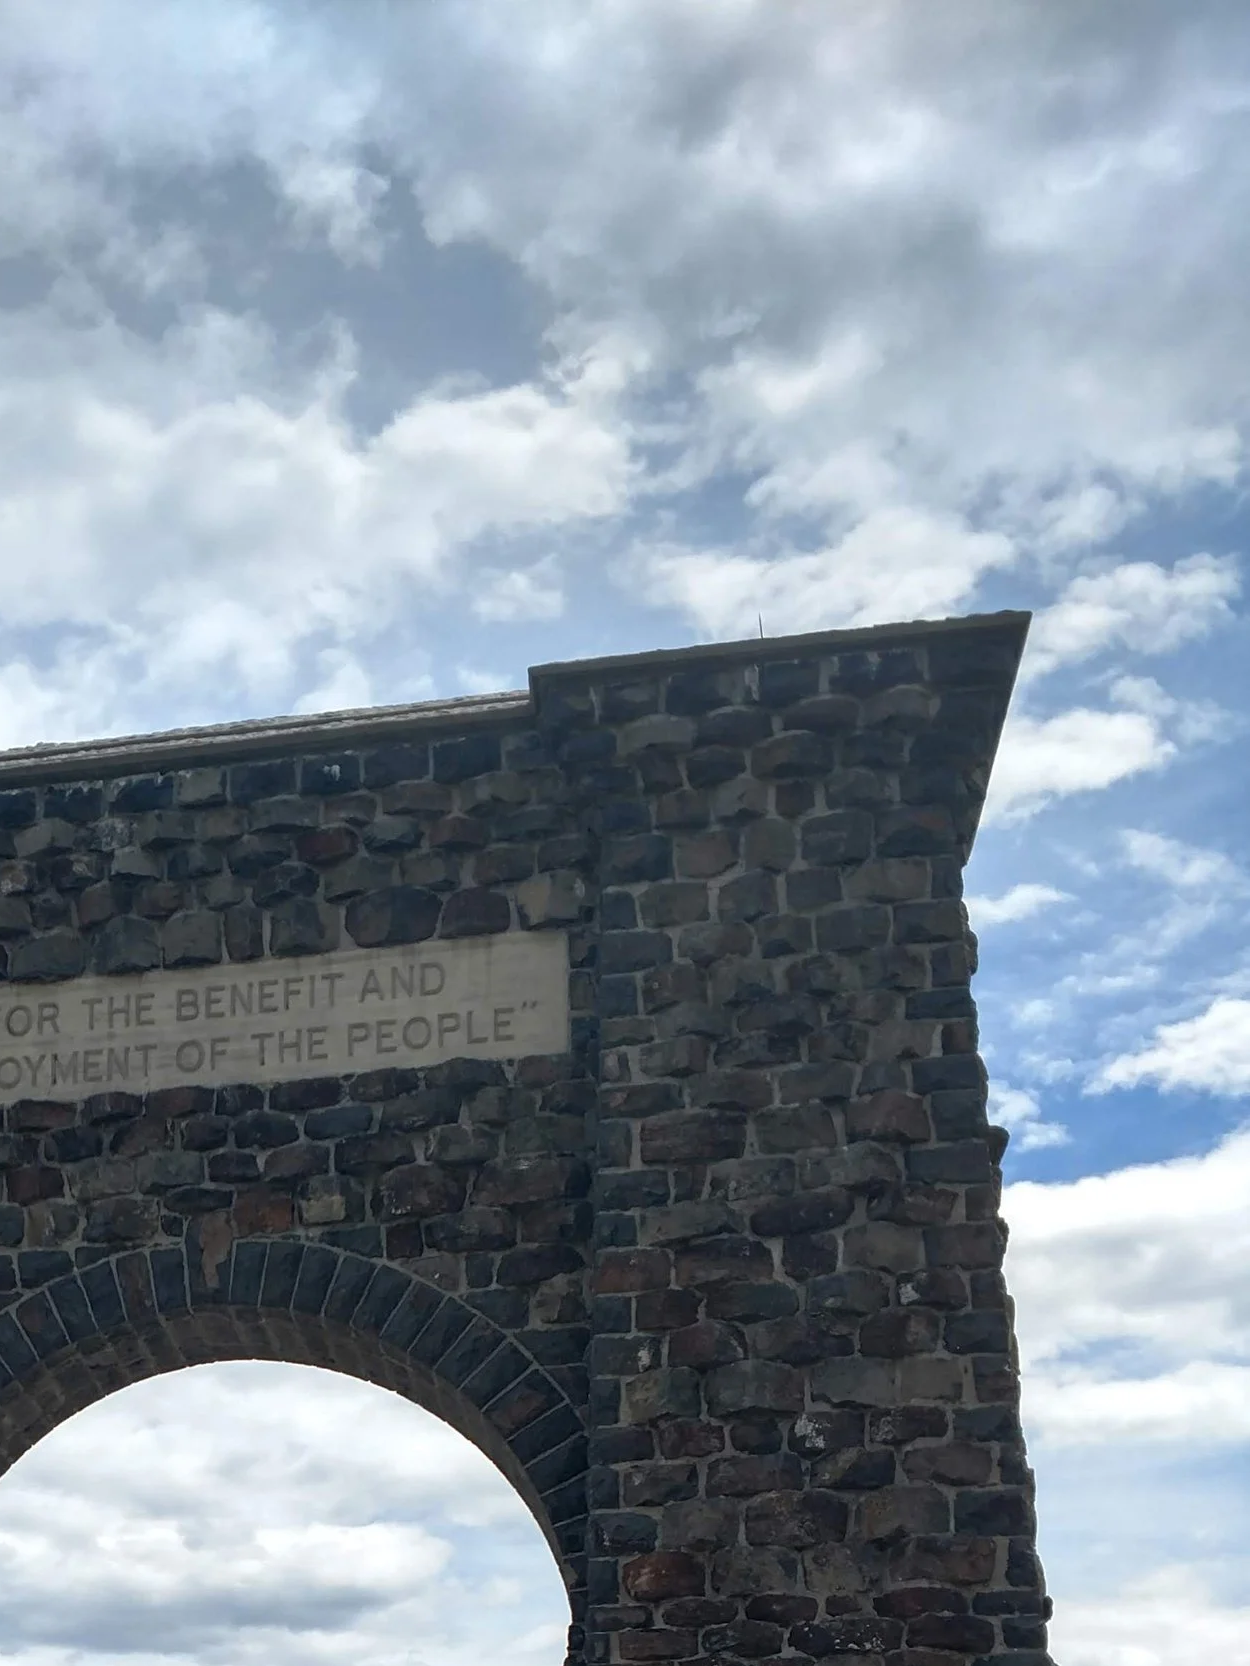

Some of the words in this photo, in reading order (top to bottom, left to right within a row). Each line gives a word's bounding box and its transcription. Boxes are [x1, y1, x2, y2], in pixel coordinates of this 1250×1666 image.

[81, 993, 156, 1031] THE
[175, 972, 346, 1023] BENEFIT
[358, 961, 447, 1003] AND
[175, 1036, 231, 1073] OF
[250, 1026, 329, 1067] THE
